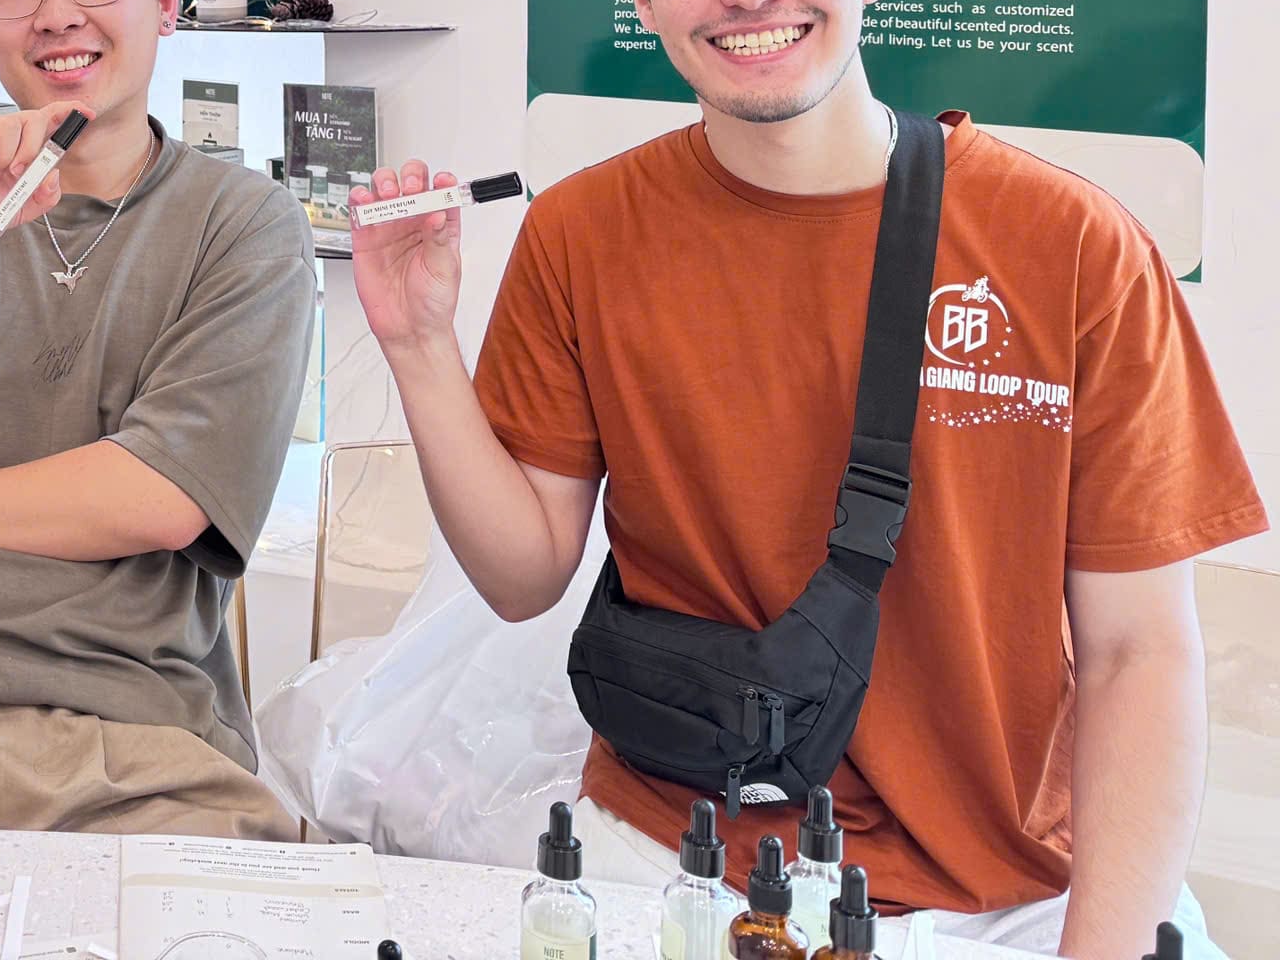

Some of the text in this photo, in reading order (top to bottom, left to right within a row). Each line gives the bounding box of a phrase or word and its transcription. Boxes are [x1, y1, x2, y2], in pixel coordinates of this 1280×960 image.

[875, 1, 1074, 17] services such as customized
[880, 17, 1074, 35] of beautiful scented products.
[614, 23, 631, 34] We
[888, 34, 926, 49] living.
[932, 36, 951, 48] Let
[957, 38, 971, 49] us
[978, 38, 994, 49] be
[1000, 40, 1031, 54] your
[1037, 42, 1074, 54] scent
[614, 40, 656, 52] experts!
[295, 111, 328, 124] MUA 1
[305, 125, 342, 141] TẶNG 1
[942, 304, 989, 354] BB
[926, 366, 976, 387] GIANG
[979, 373, 1022, 397] LOOP
[1025, 379, 1070, 406] TOUR
[543, 946, 565, 960] NOTE
